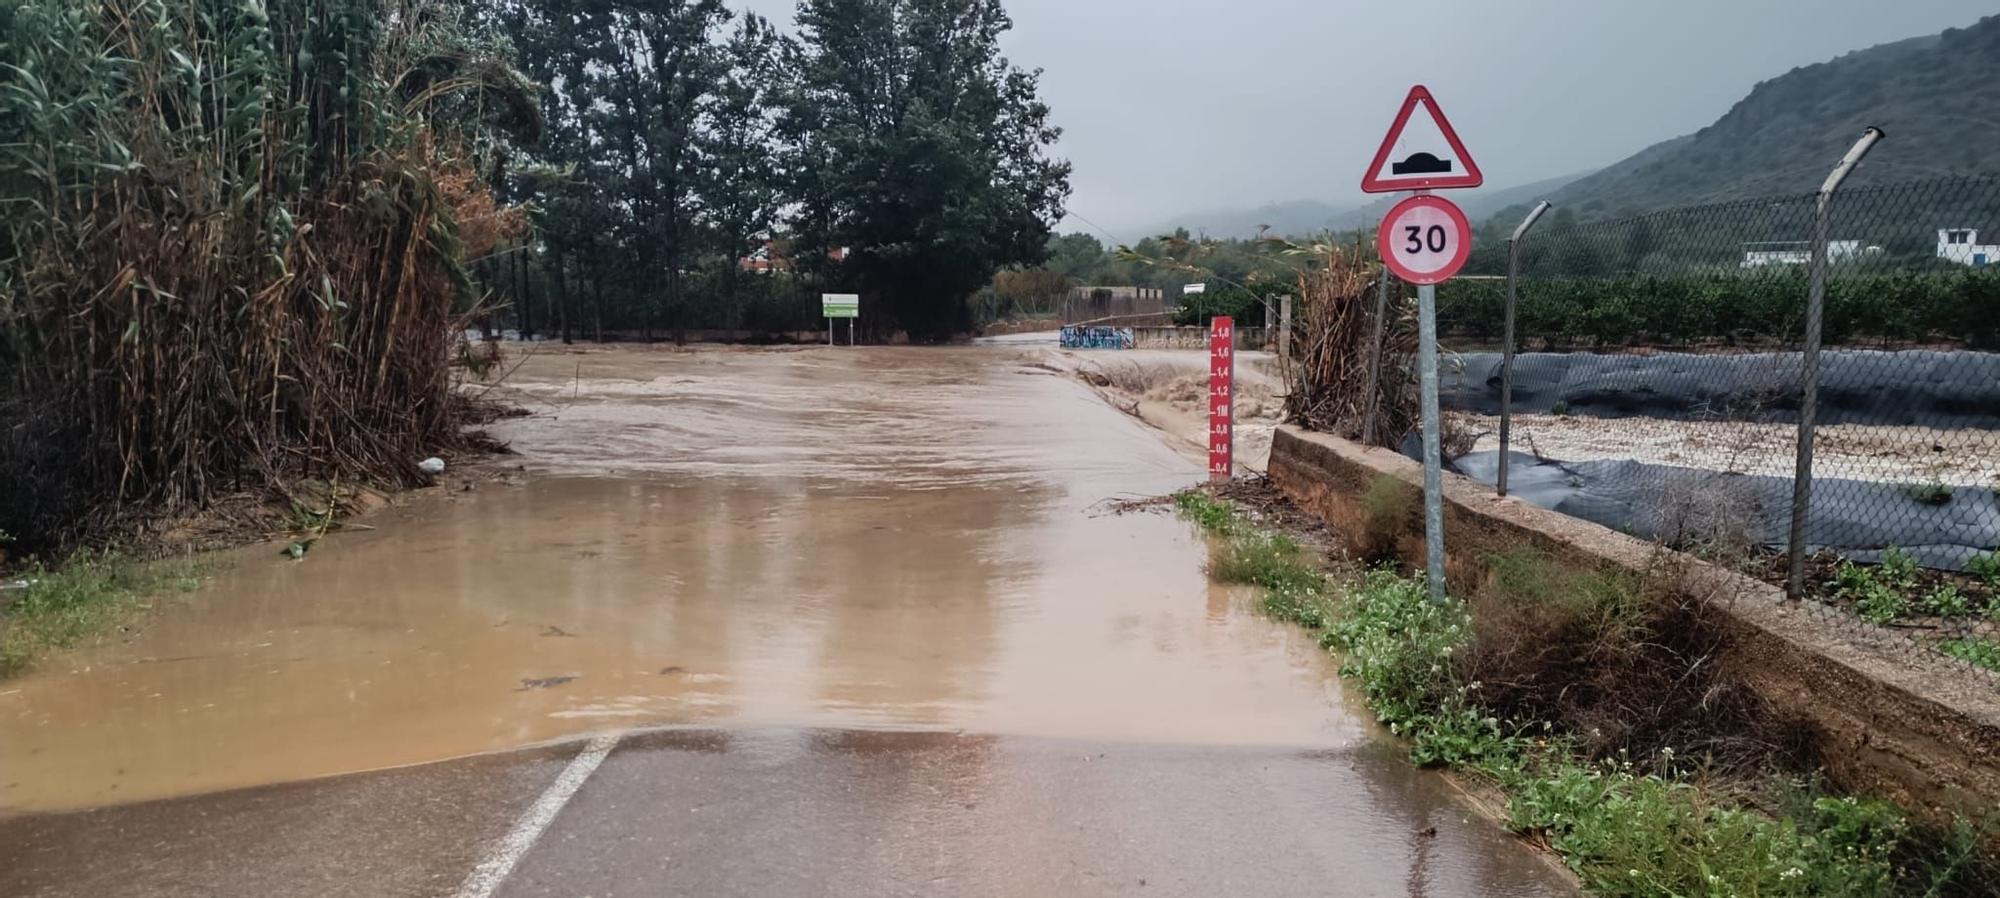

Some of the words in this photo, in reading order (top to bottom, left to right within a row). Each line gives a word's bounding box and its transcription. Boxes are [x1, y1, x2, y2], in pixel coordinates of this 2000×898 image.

[1404, 224, 1446, 254] 30
[1218, 327, 1229, 339] 1,8
[1218, 347, 1229, 359] 1,6
[1217, 366, 1228, 378] 1,4
[1217, 385, 1228, 397] 1,2
[1216, 424, 1227, 436] 0,8
[1215, 443, 1227, 455] 0,6
[1215, 462, 1227, 474] 0,4
